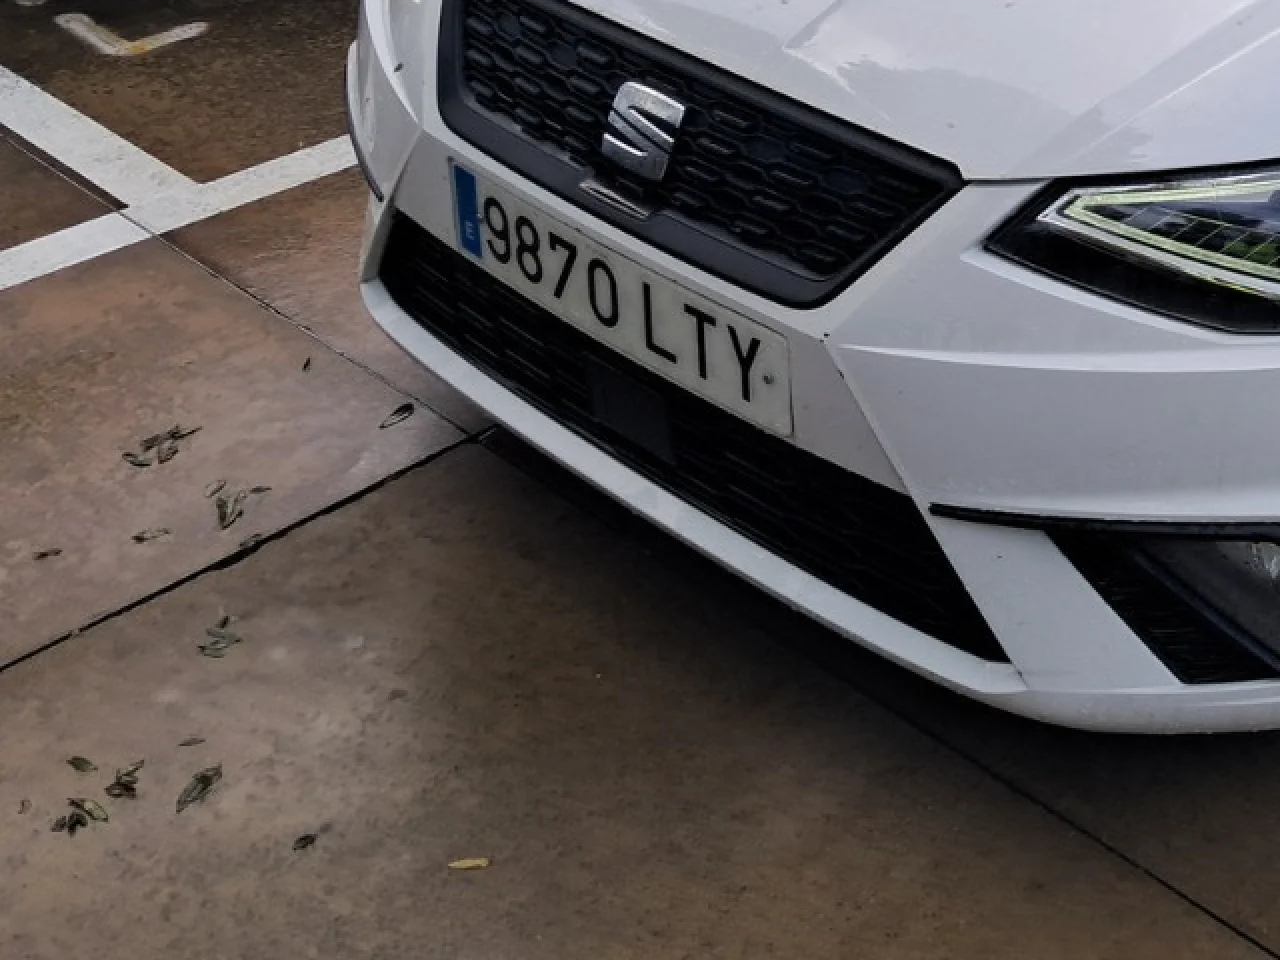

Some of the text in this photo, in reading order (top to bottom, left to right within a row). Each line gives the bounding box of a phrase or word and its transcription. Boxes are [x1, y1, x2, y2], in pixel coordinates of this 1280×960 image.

[464, 196, 761, 403] E 9870 LTY
